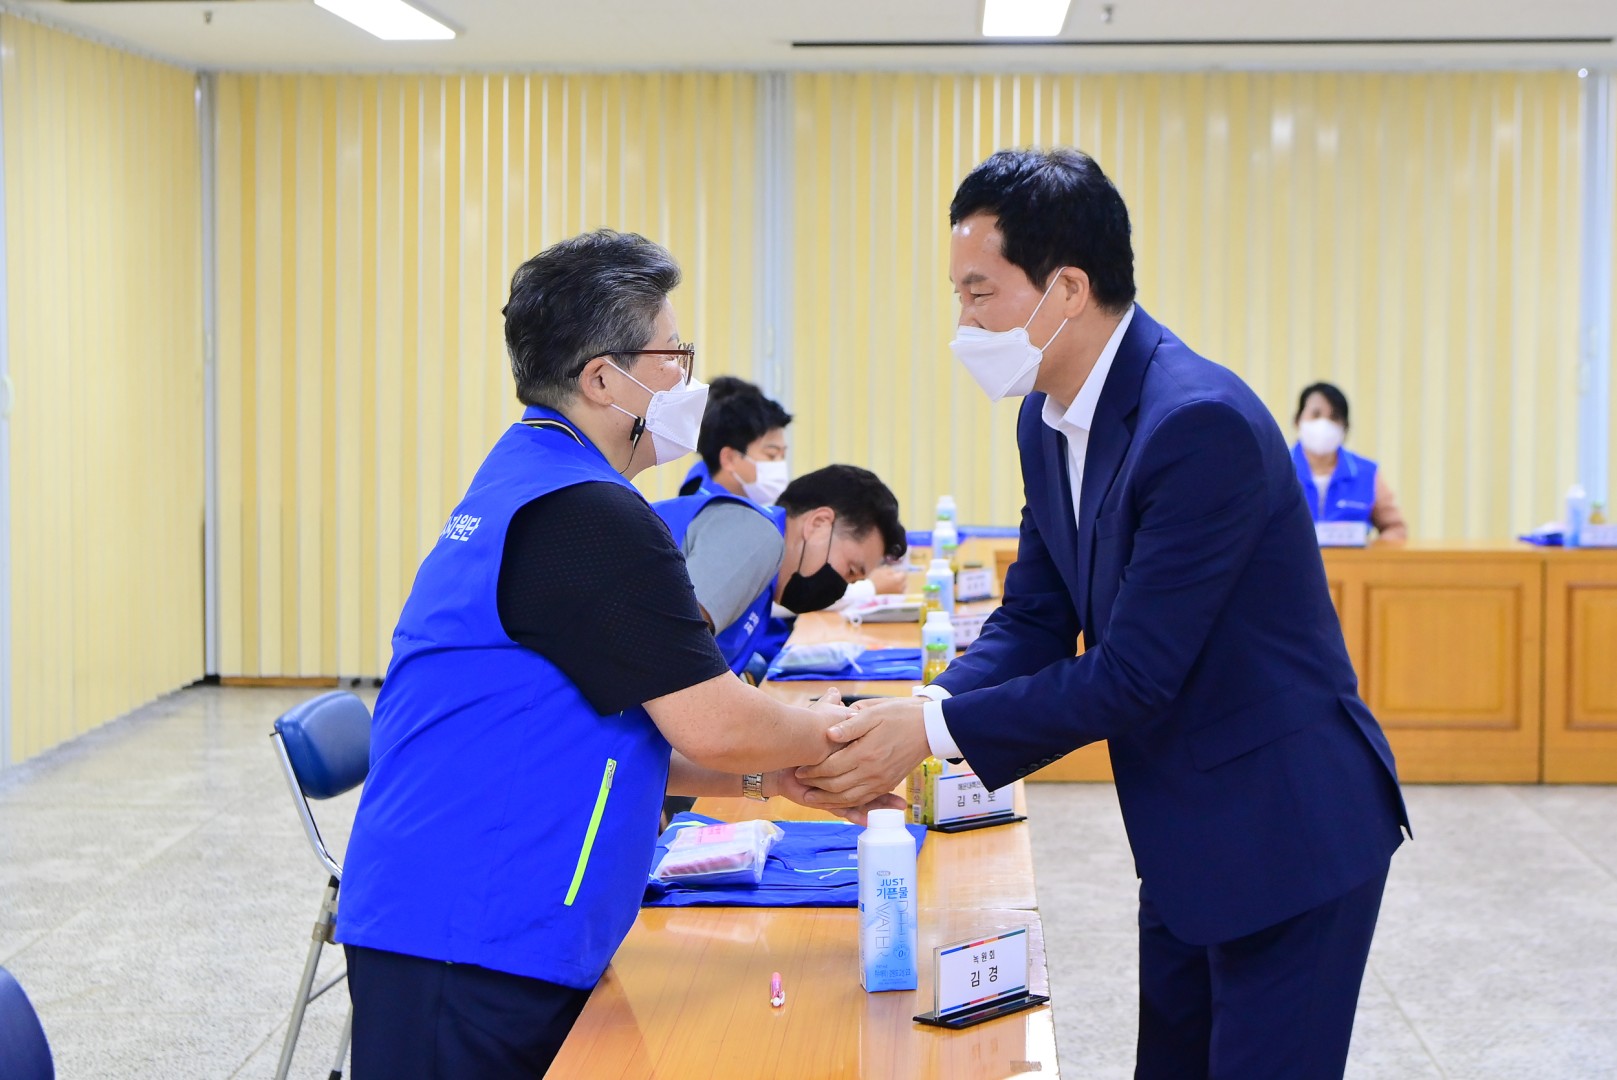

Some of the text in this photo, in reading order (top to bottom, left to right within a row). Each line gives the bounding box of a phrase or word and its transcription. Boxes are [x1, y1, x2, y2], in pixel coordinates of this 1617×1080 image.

[880, 878, 904, 887] JUST
[876, 887, 909, 900] 기픈물
[875, 902, 890, 958] WATER
[973, 950, 995, 964] 녹원회
